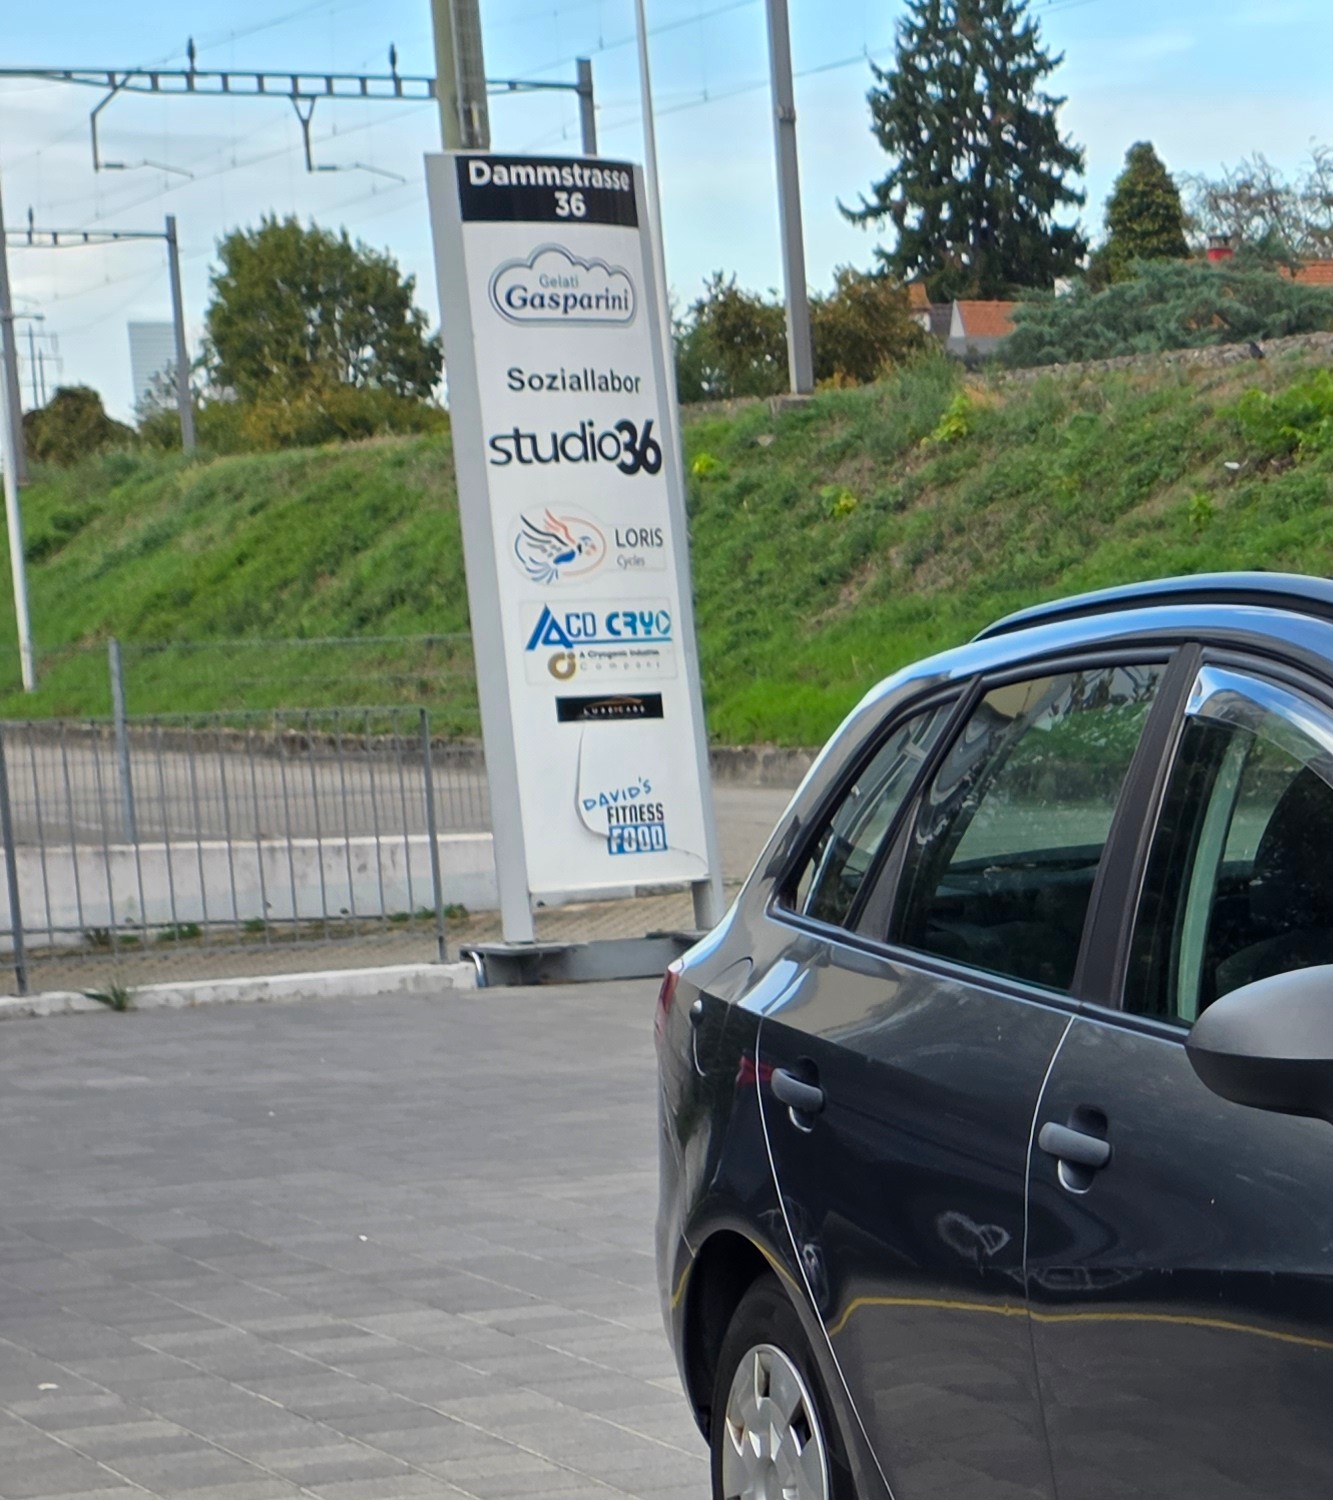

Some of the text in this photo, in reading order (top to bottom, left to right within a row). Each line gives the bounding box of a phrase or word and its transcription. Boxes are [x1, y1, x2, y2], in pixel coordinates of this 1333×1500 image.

[468, 159, 630, 192] Dammstrasse
[554, 192, 587, 218] 36
[538, 273, 579, 290] Gelati
[505, 283, 630, 315] Gasparini
[507, 367, 640, 394] Soziallabor
[615, 526, 664, 549] LORIS
[582, 777, 652, 812] DAVID'S
[606, 802, 665, 825] FITNESS
[610, 824, 665, 855] FOOD
